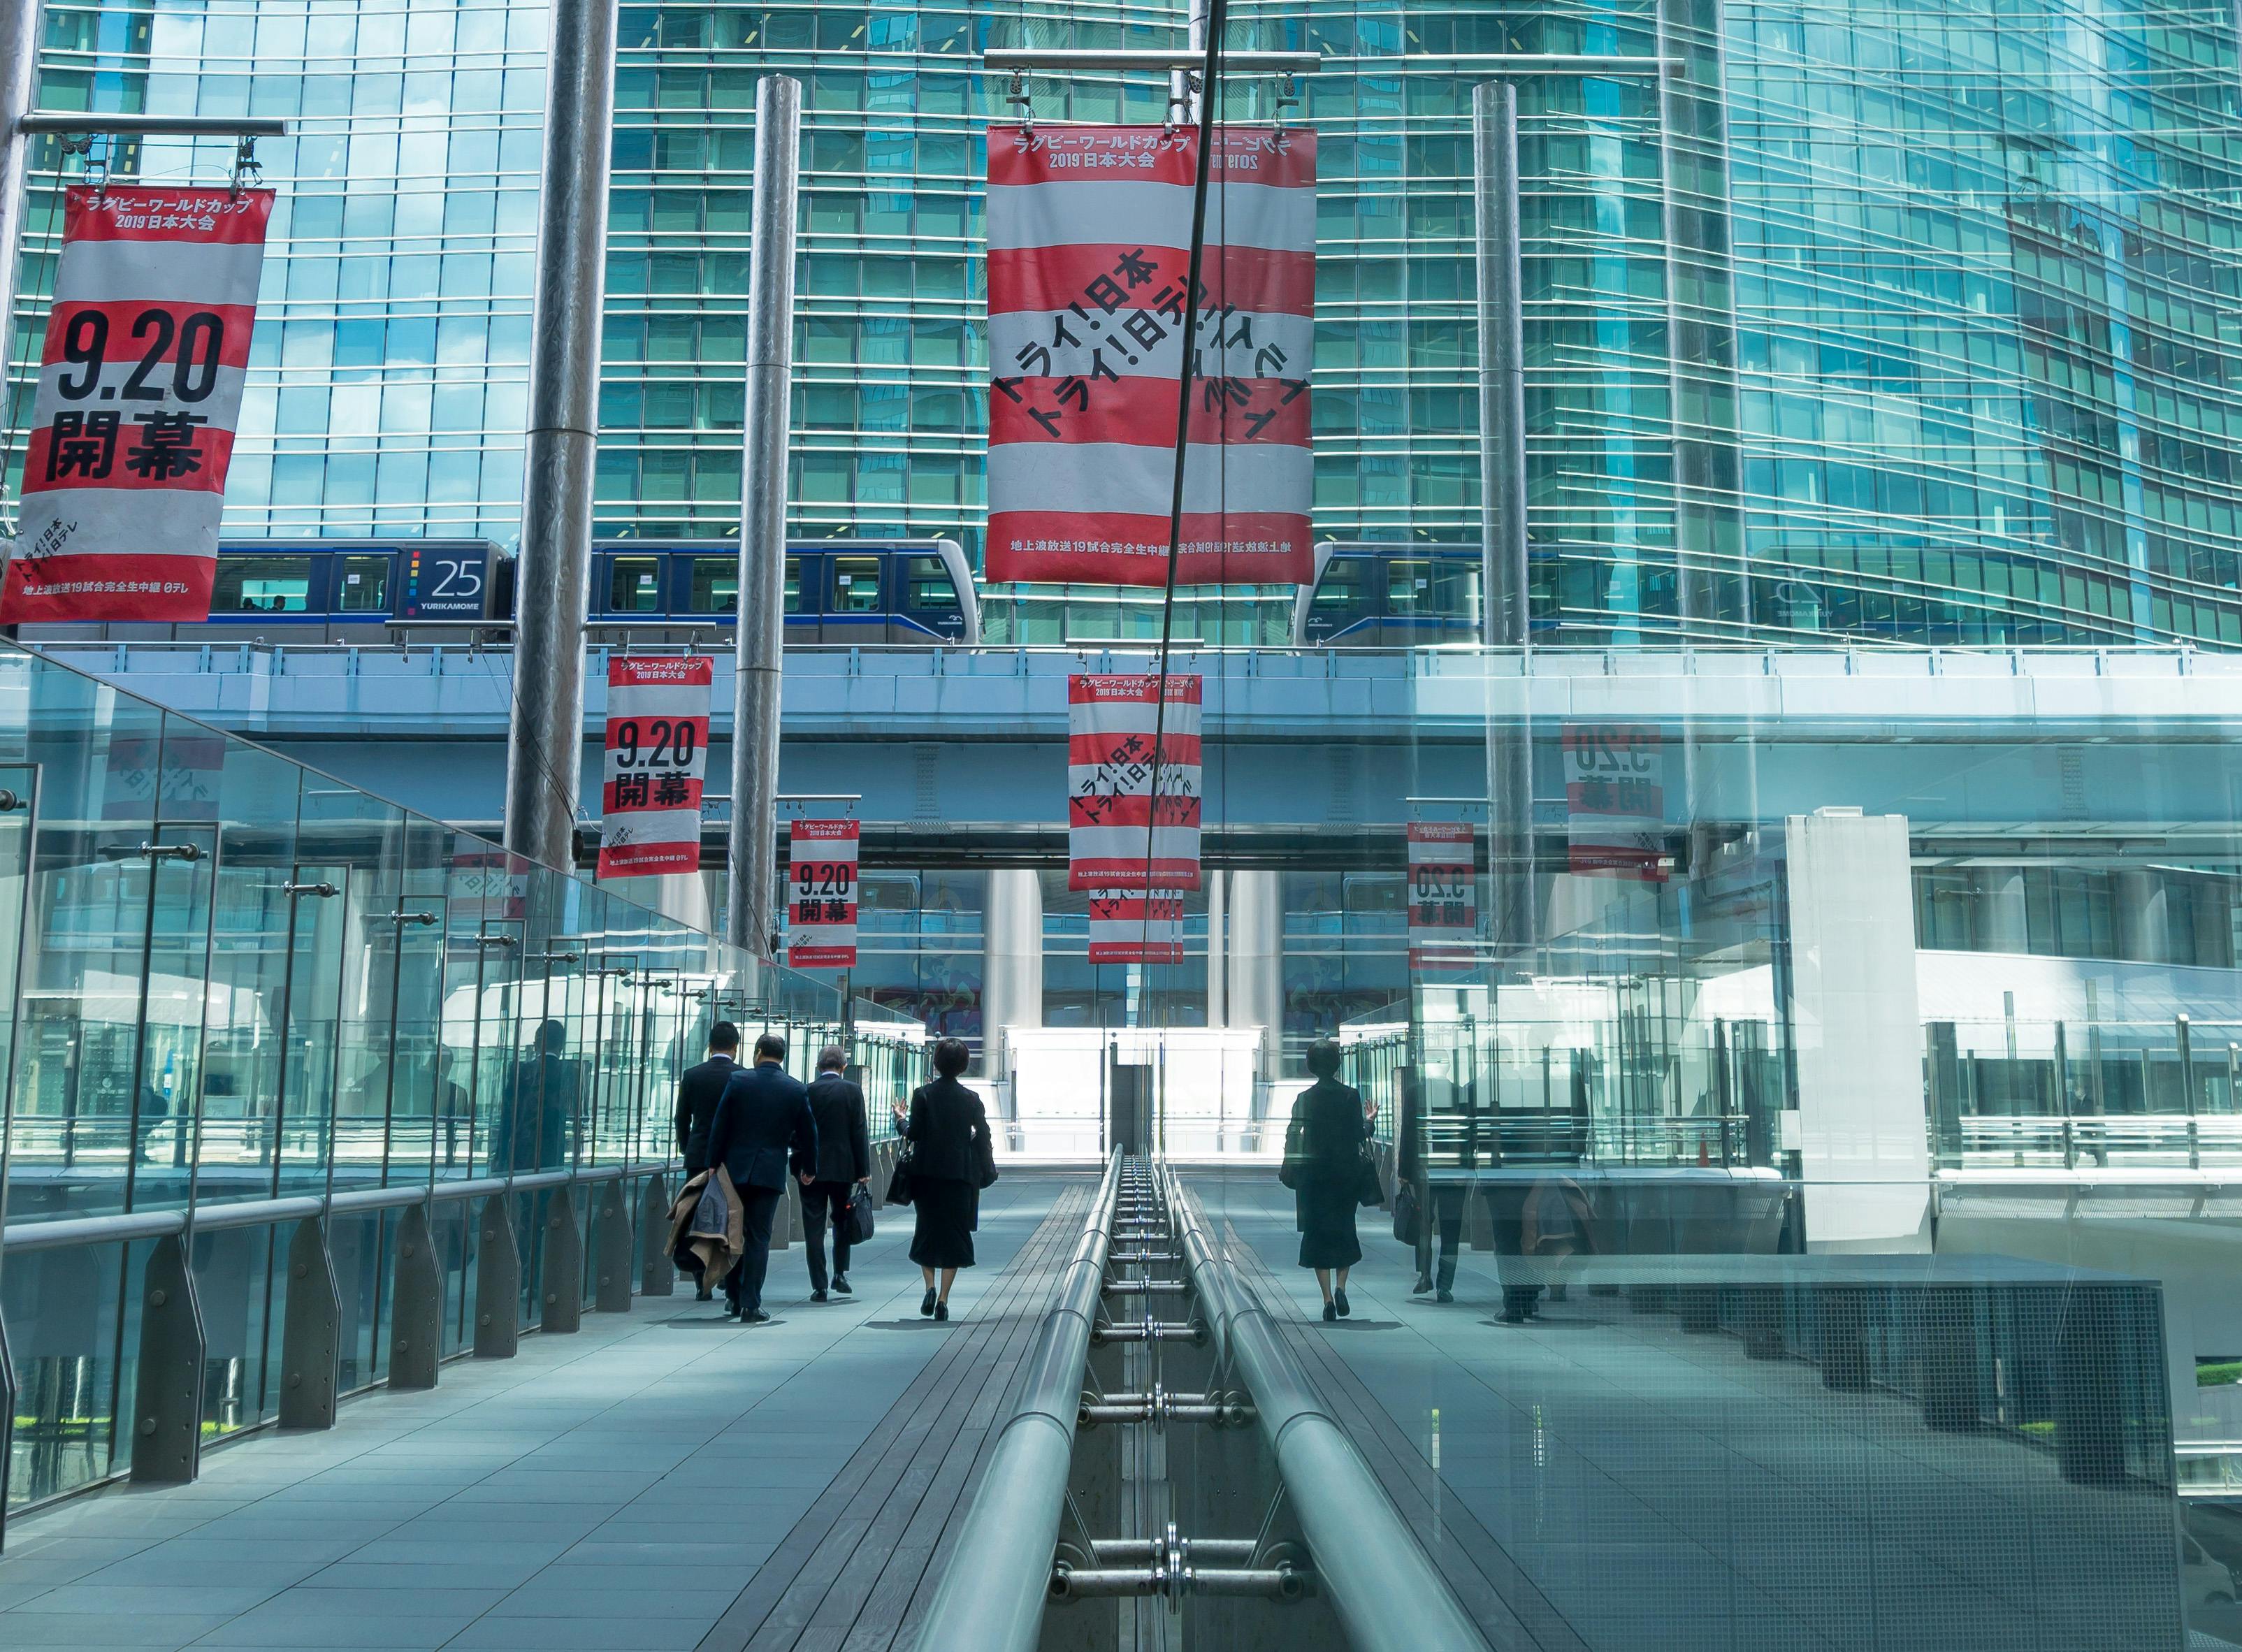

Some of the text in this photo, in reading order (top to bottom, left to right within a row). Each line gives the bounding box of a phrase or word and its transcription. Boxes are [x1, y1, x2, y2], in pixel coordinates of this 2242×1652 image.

[1013, 135, 1191, 154] ラグビーワールドカップ
[86, 196, 254, 214] ラグビーワールドカップ
[58, 308, 224, 403] 9.20
[46, 410, 208, 481] 開幕
[432, 560, 482, 597] 25
[616, 720, 695, 768] 9.20
[614, 770, 690, 809] 開幕
[1085, 746, 1155, 824] トライ!日テ
[799, 864, 850, 895] 9.20
[799, 898, 848, 922] 開幕
